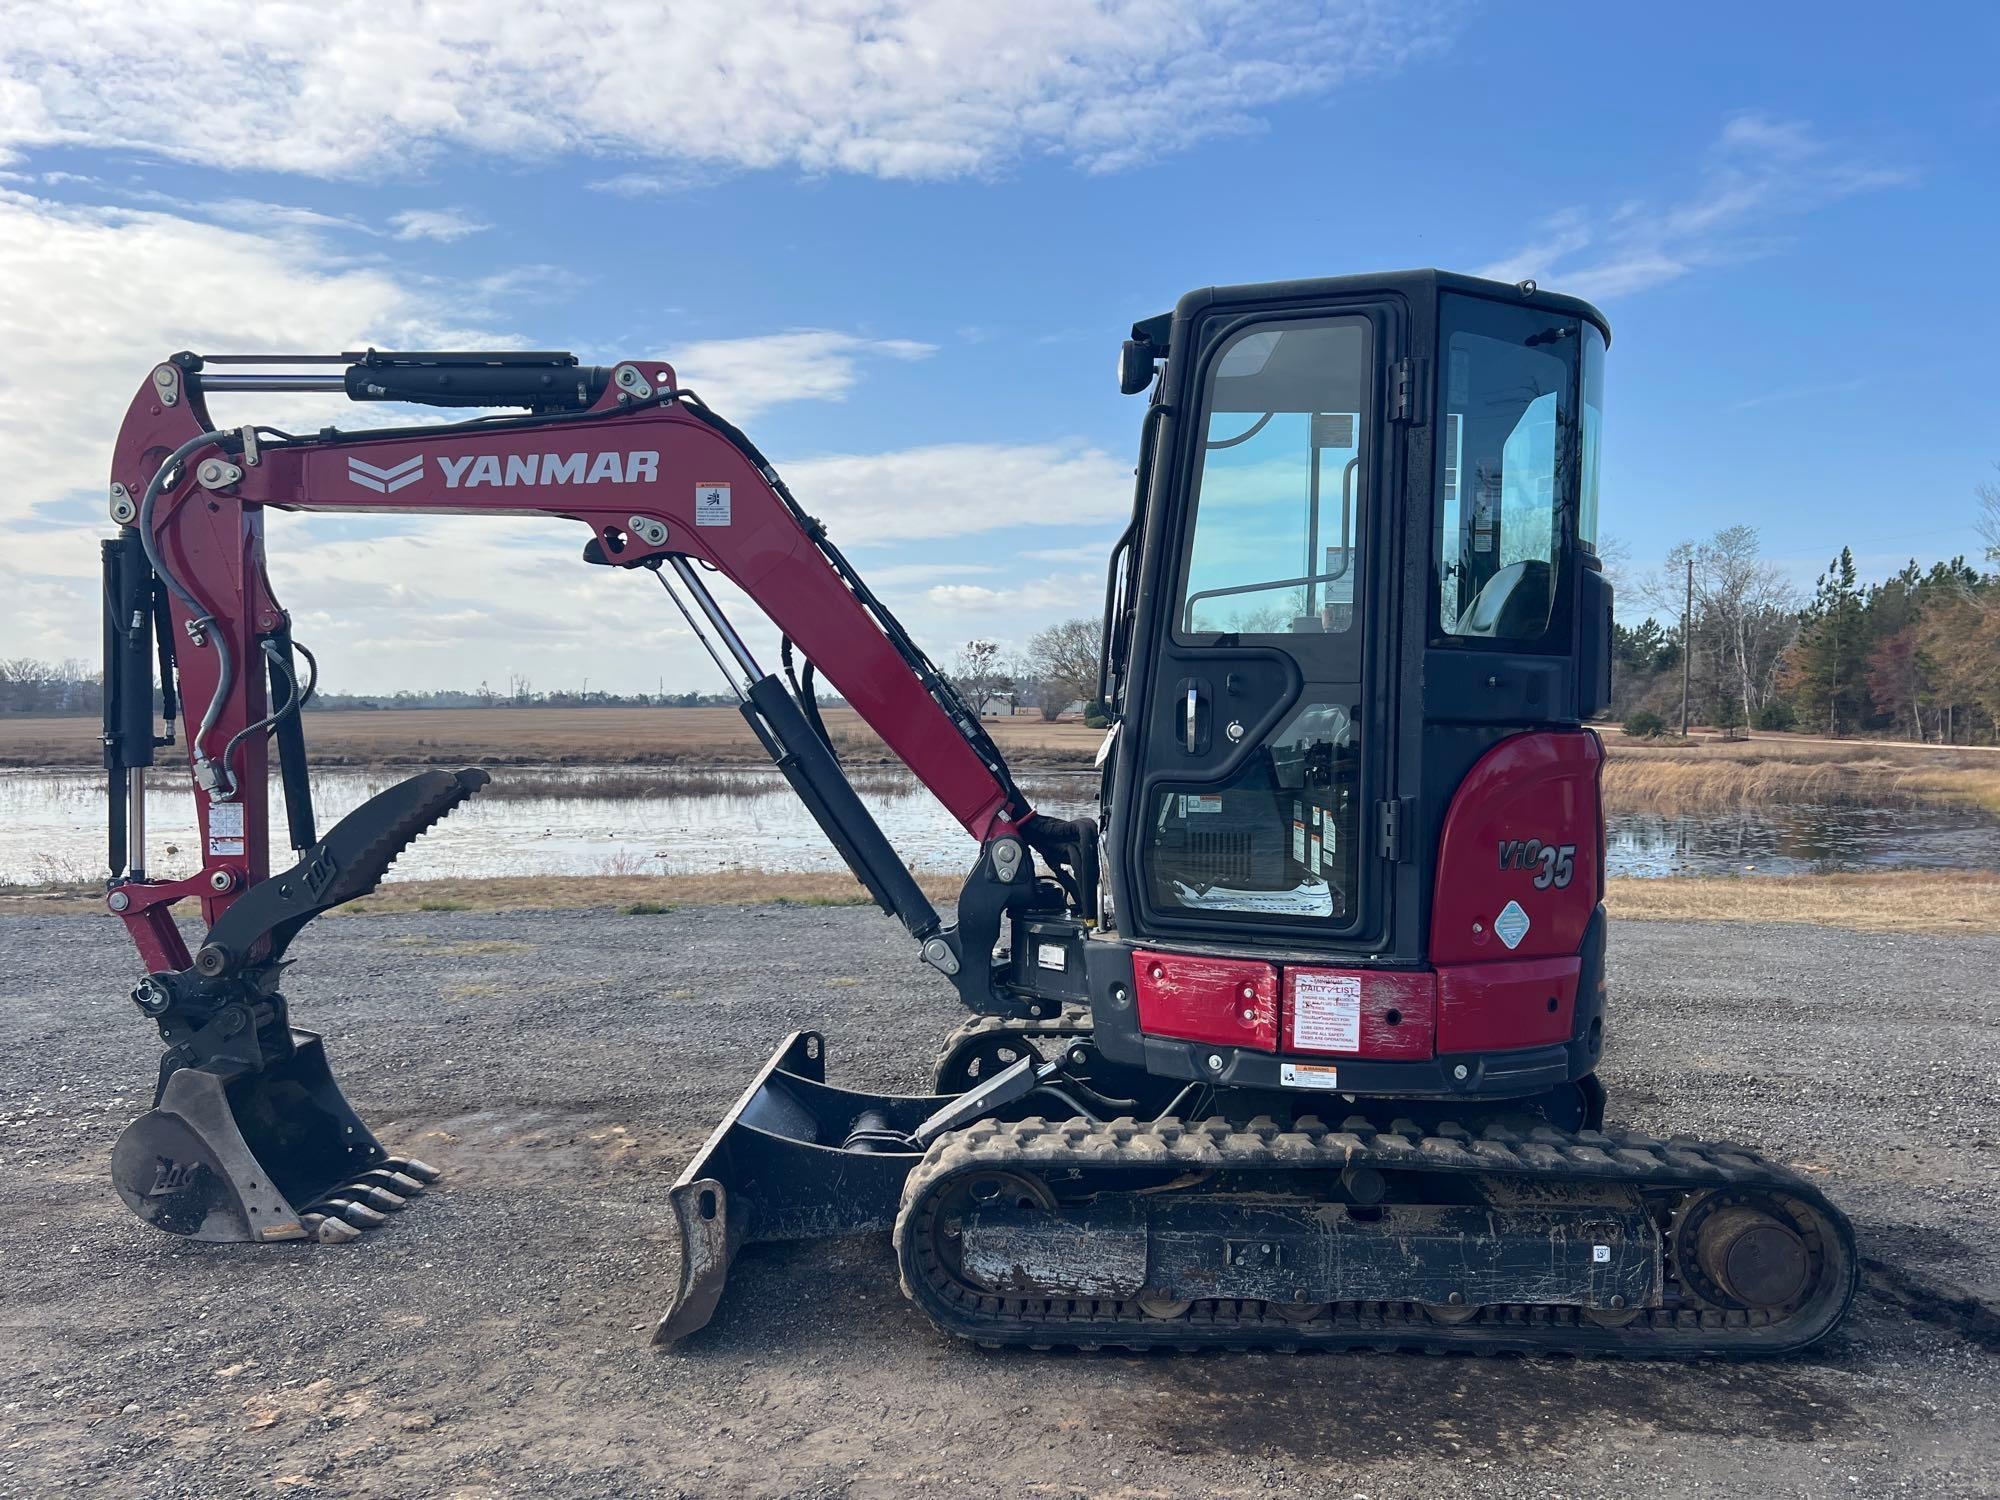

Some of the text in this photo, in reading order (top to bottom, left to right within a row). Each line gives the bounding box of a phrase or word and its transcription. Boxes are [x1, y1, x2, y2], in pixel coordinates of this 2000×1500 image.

[437, 451, 660, 487] YANMAR
[1301, 984, 1326, 992] DAILY
[1336, 986, 1354, 994] LIST
